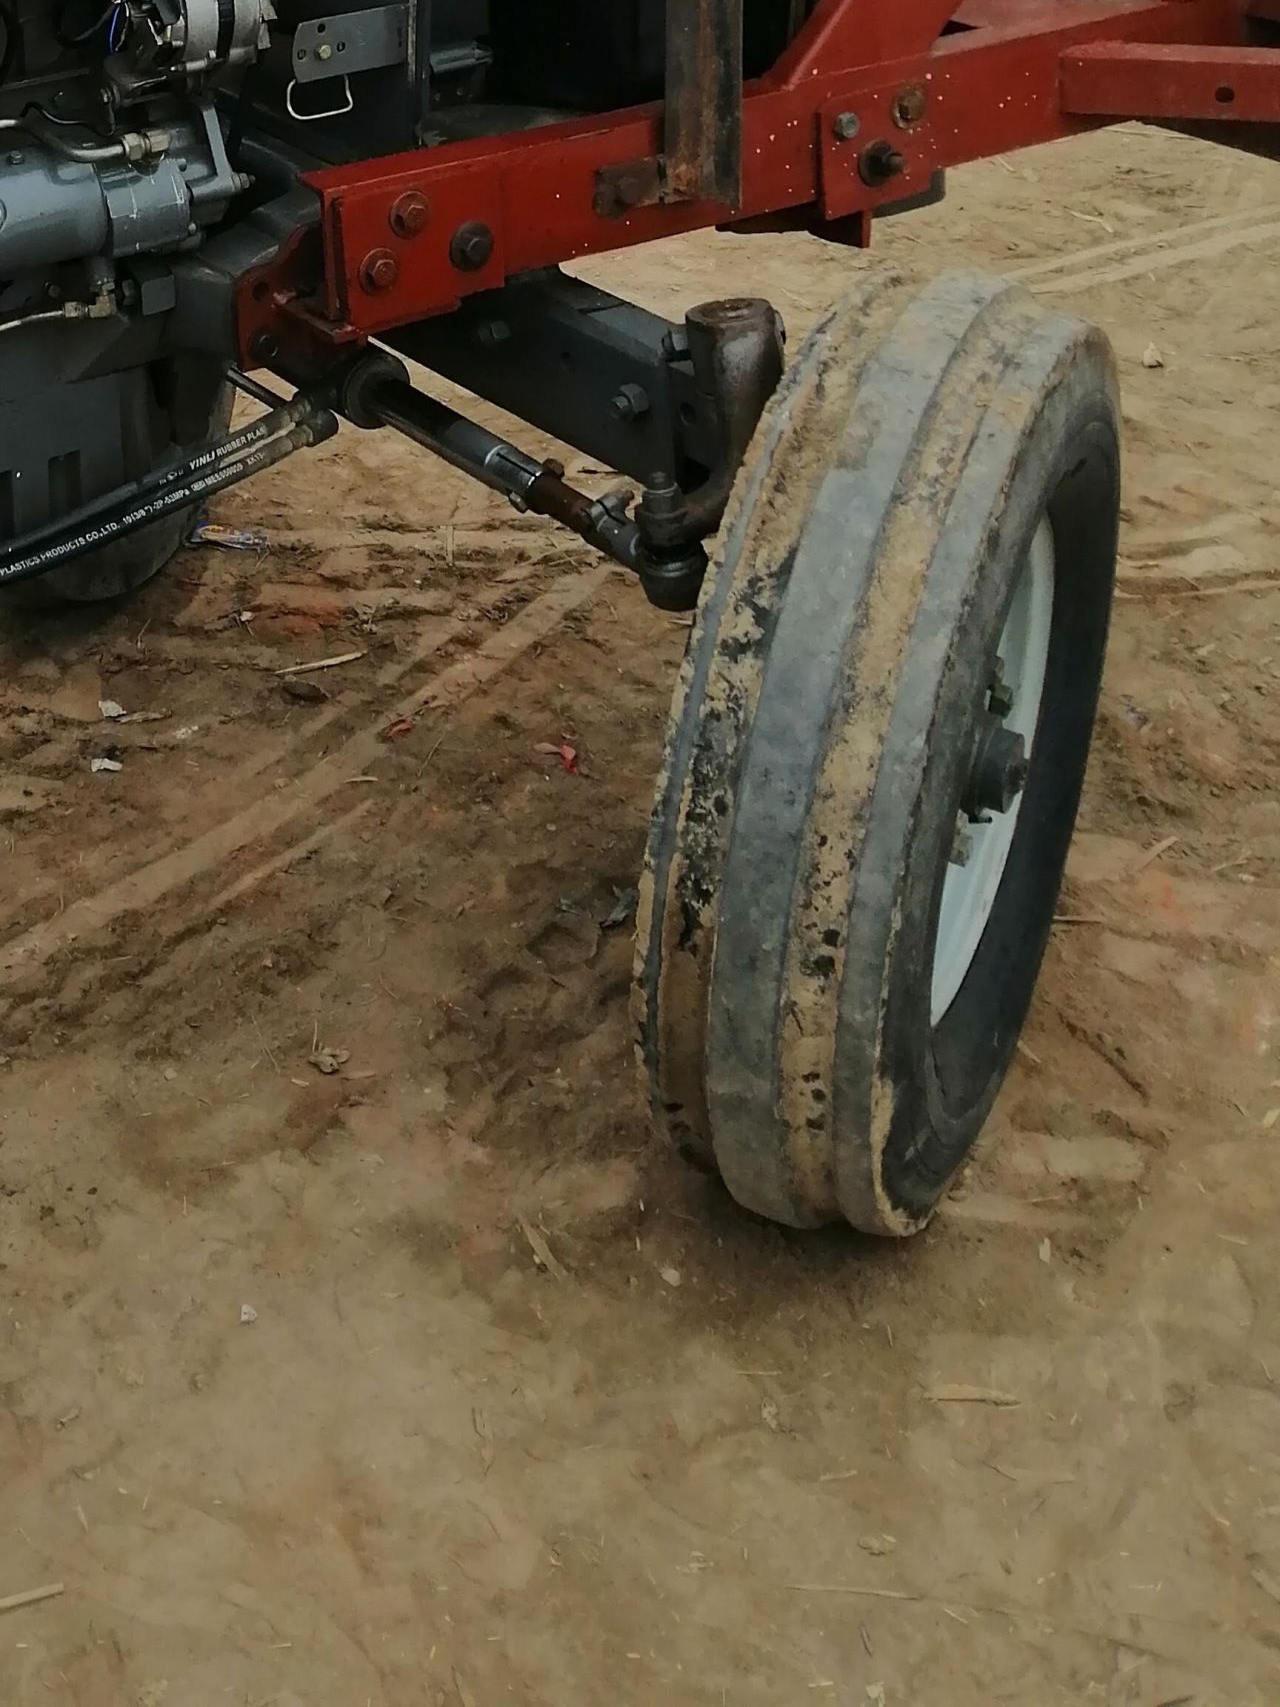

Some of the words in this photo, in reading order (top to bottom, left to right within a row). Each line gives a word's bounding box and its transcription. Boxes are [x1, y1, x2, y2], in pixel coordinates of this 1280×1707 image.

[215, 436, 247, 458] RUBBER
[0, 554, 41, 577] PLASTICS
[40, 535, 86, 562] PRODUCTS
